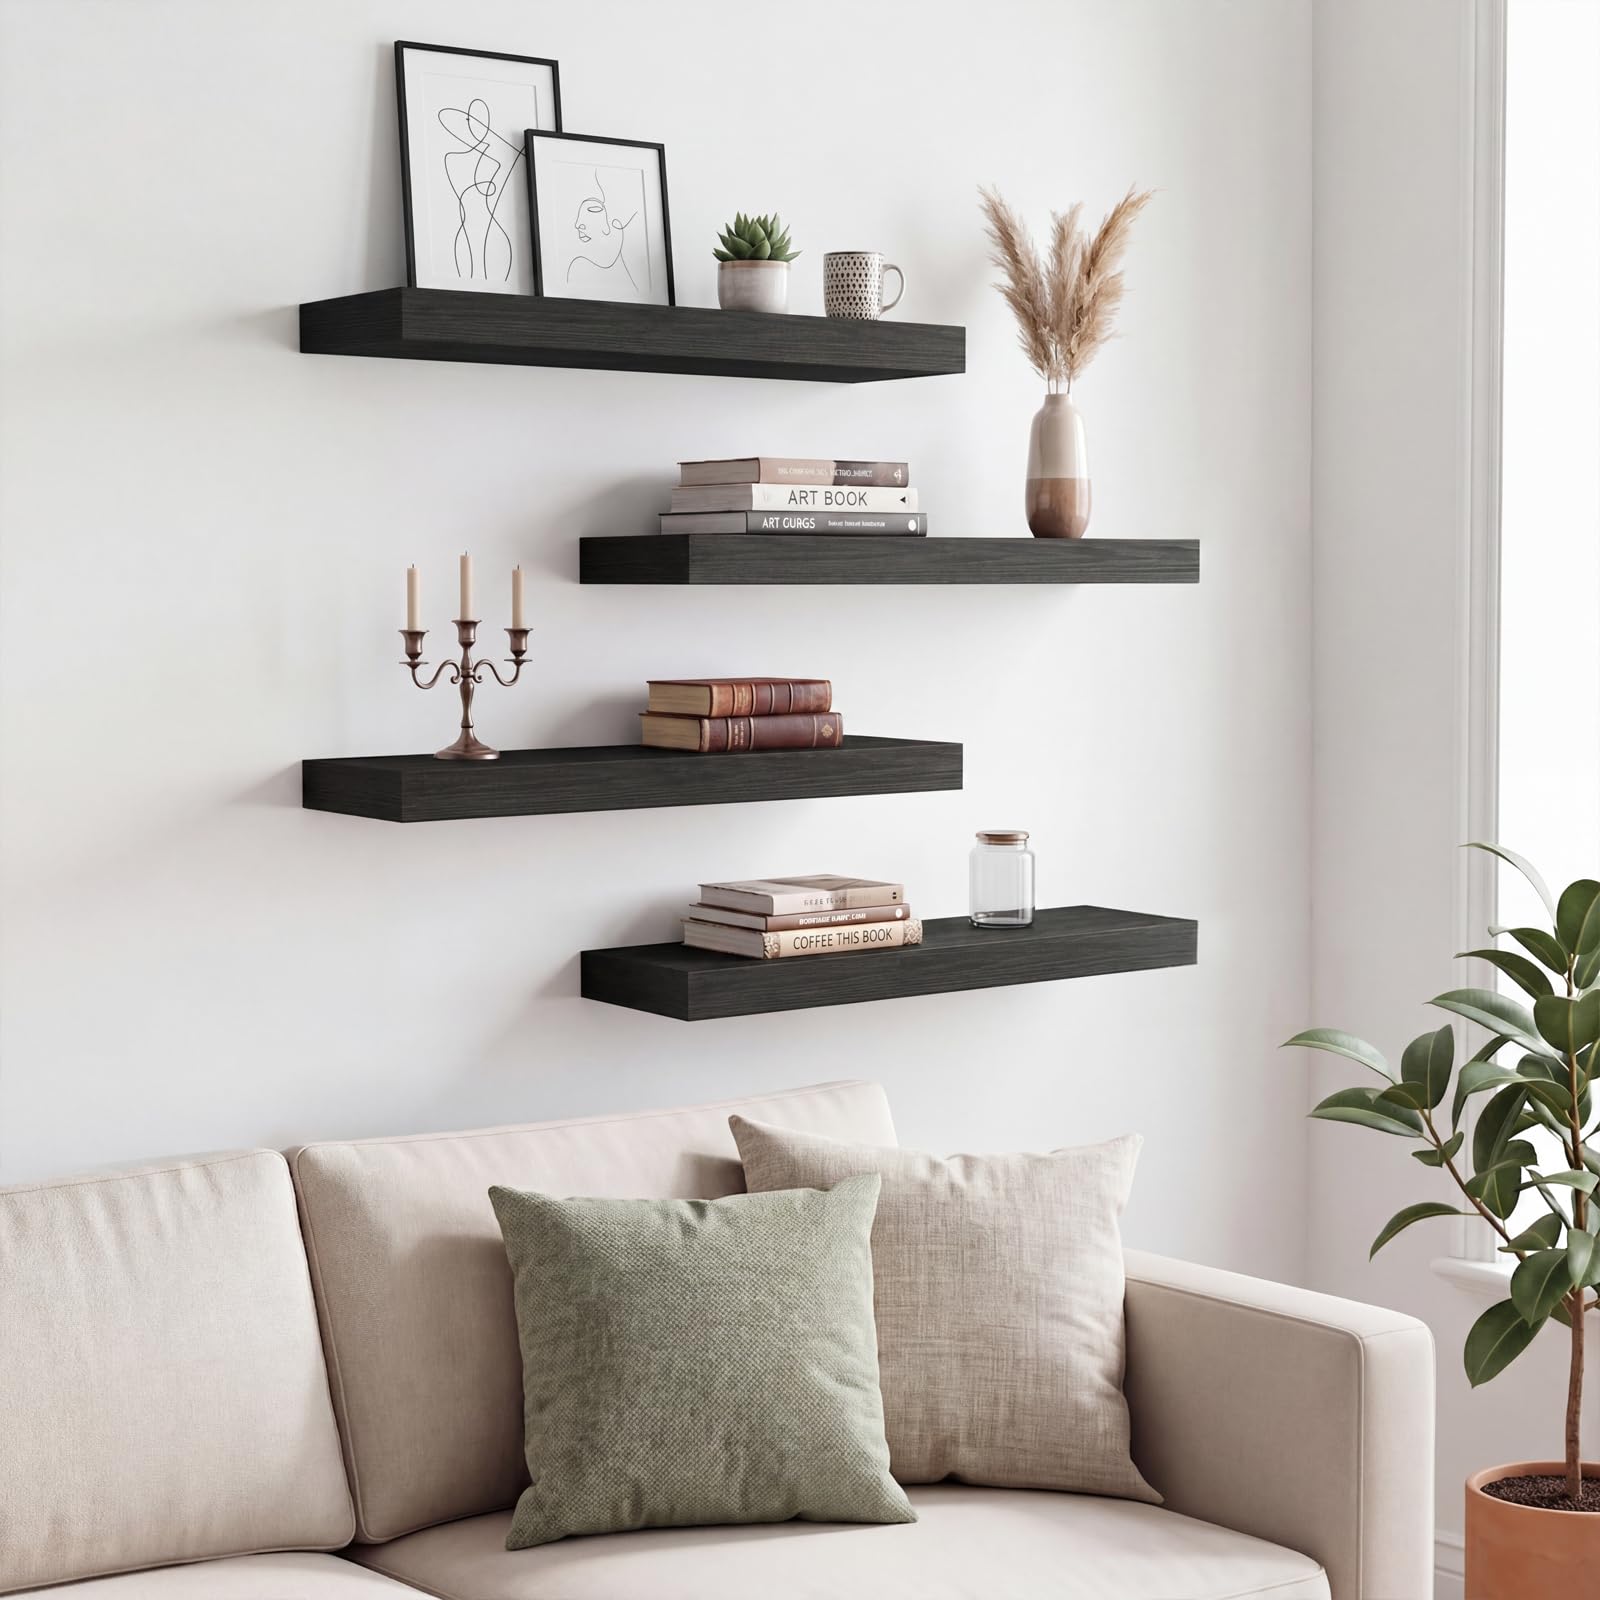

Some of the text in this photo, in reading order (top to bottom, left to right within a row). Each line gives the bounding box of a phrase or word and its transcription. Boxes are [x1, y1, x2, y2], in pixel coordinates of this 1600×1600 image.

[788, 490, 868, 506] ART BOOK
[762, 517, 780, 529] ART
[793, 928, 893, 950] COFFEE THIS BOOK
